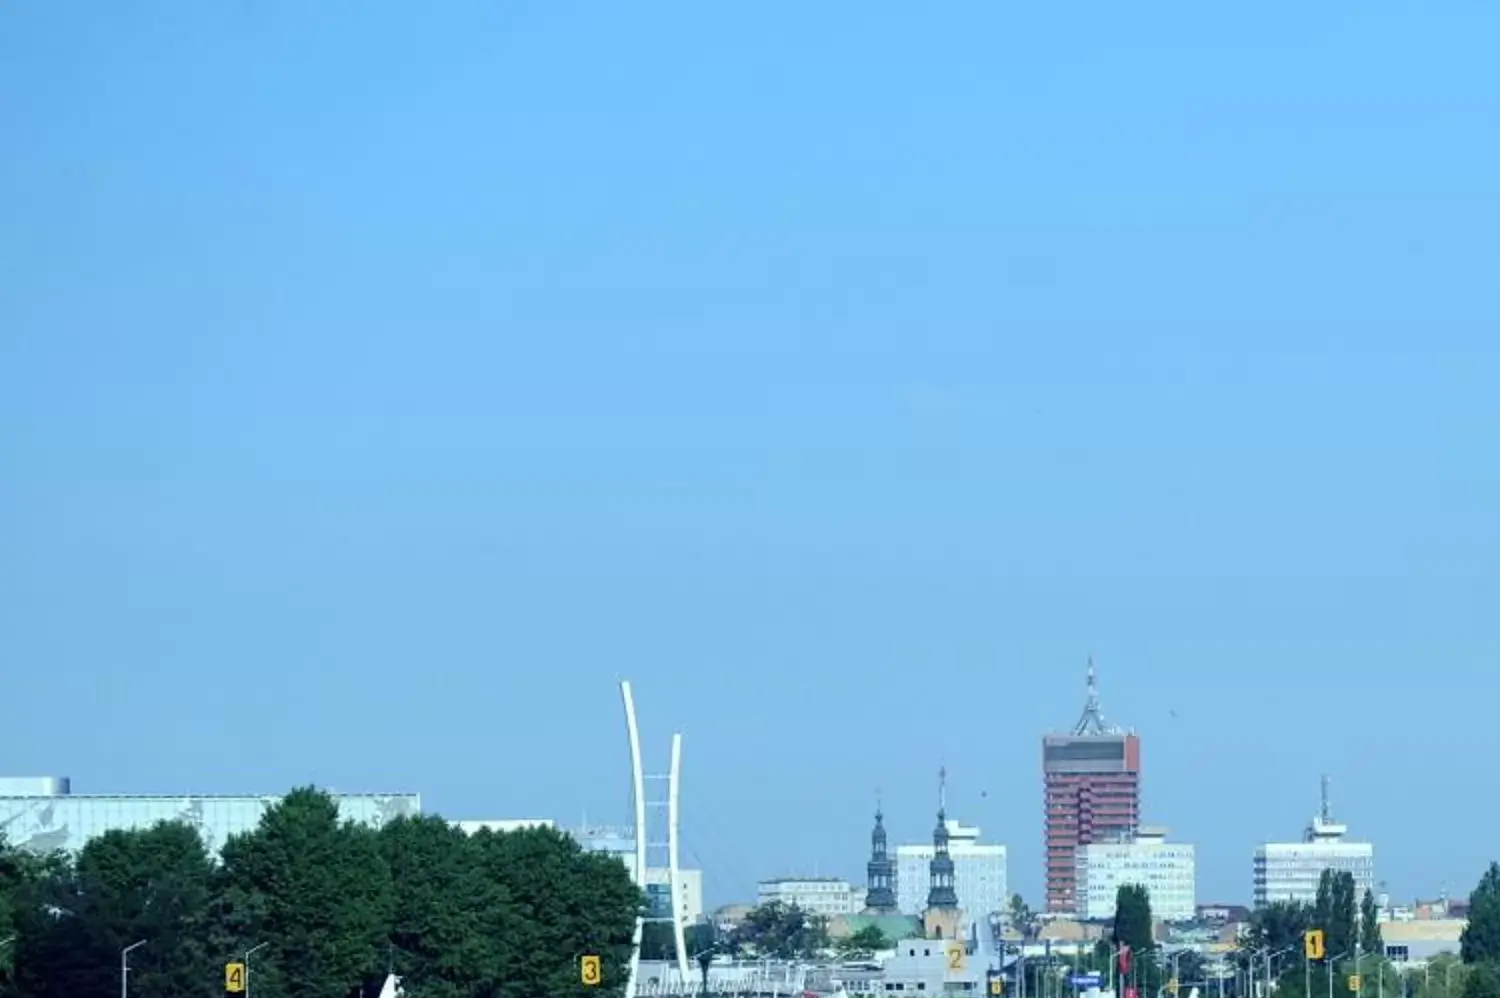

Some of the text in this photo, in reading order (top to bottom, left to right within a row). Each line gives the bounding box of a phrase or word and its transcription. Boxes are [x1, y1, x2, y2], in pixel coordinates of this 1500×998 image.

[1309, 935, 1317, 955] 1
[949, 948, 961, 969] 2
[229, 966, 241, 988] 4
[584, 960, 597, 981] 3
